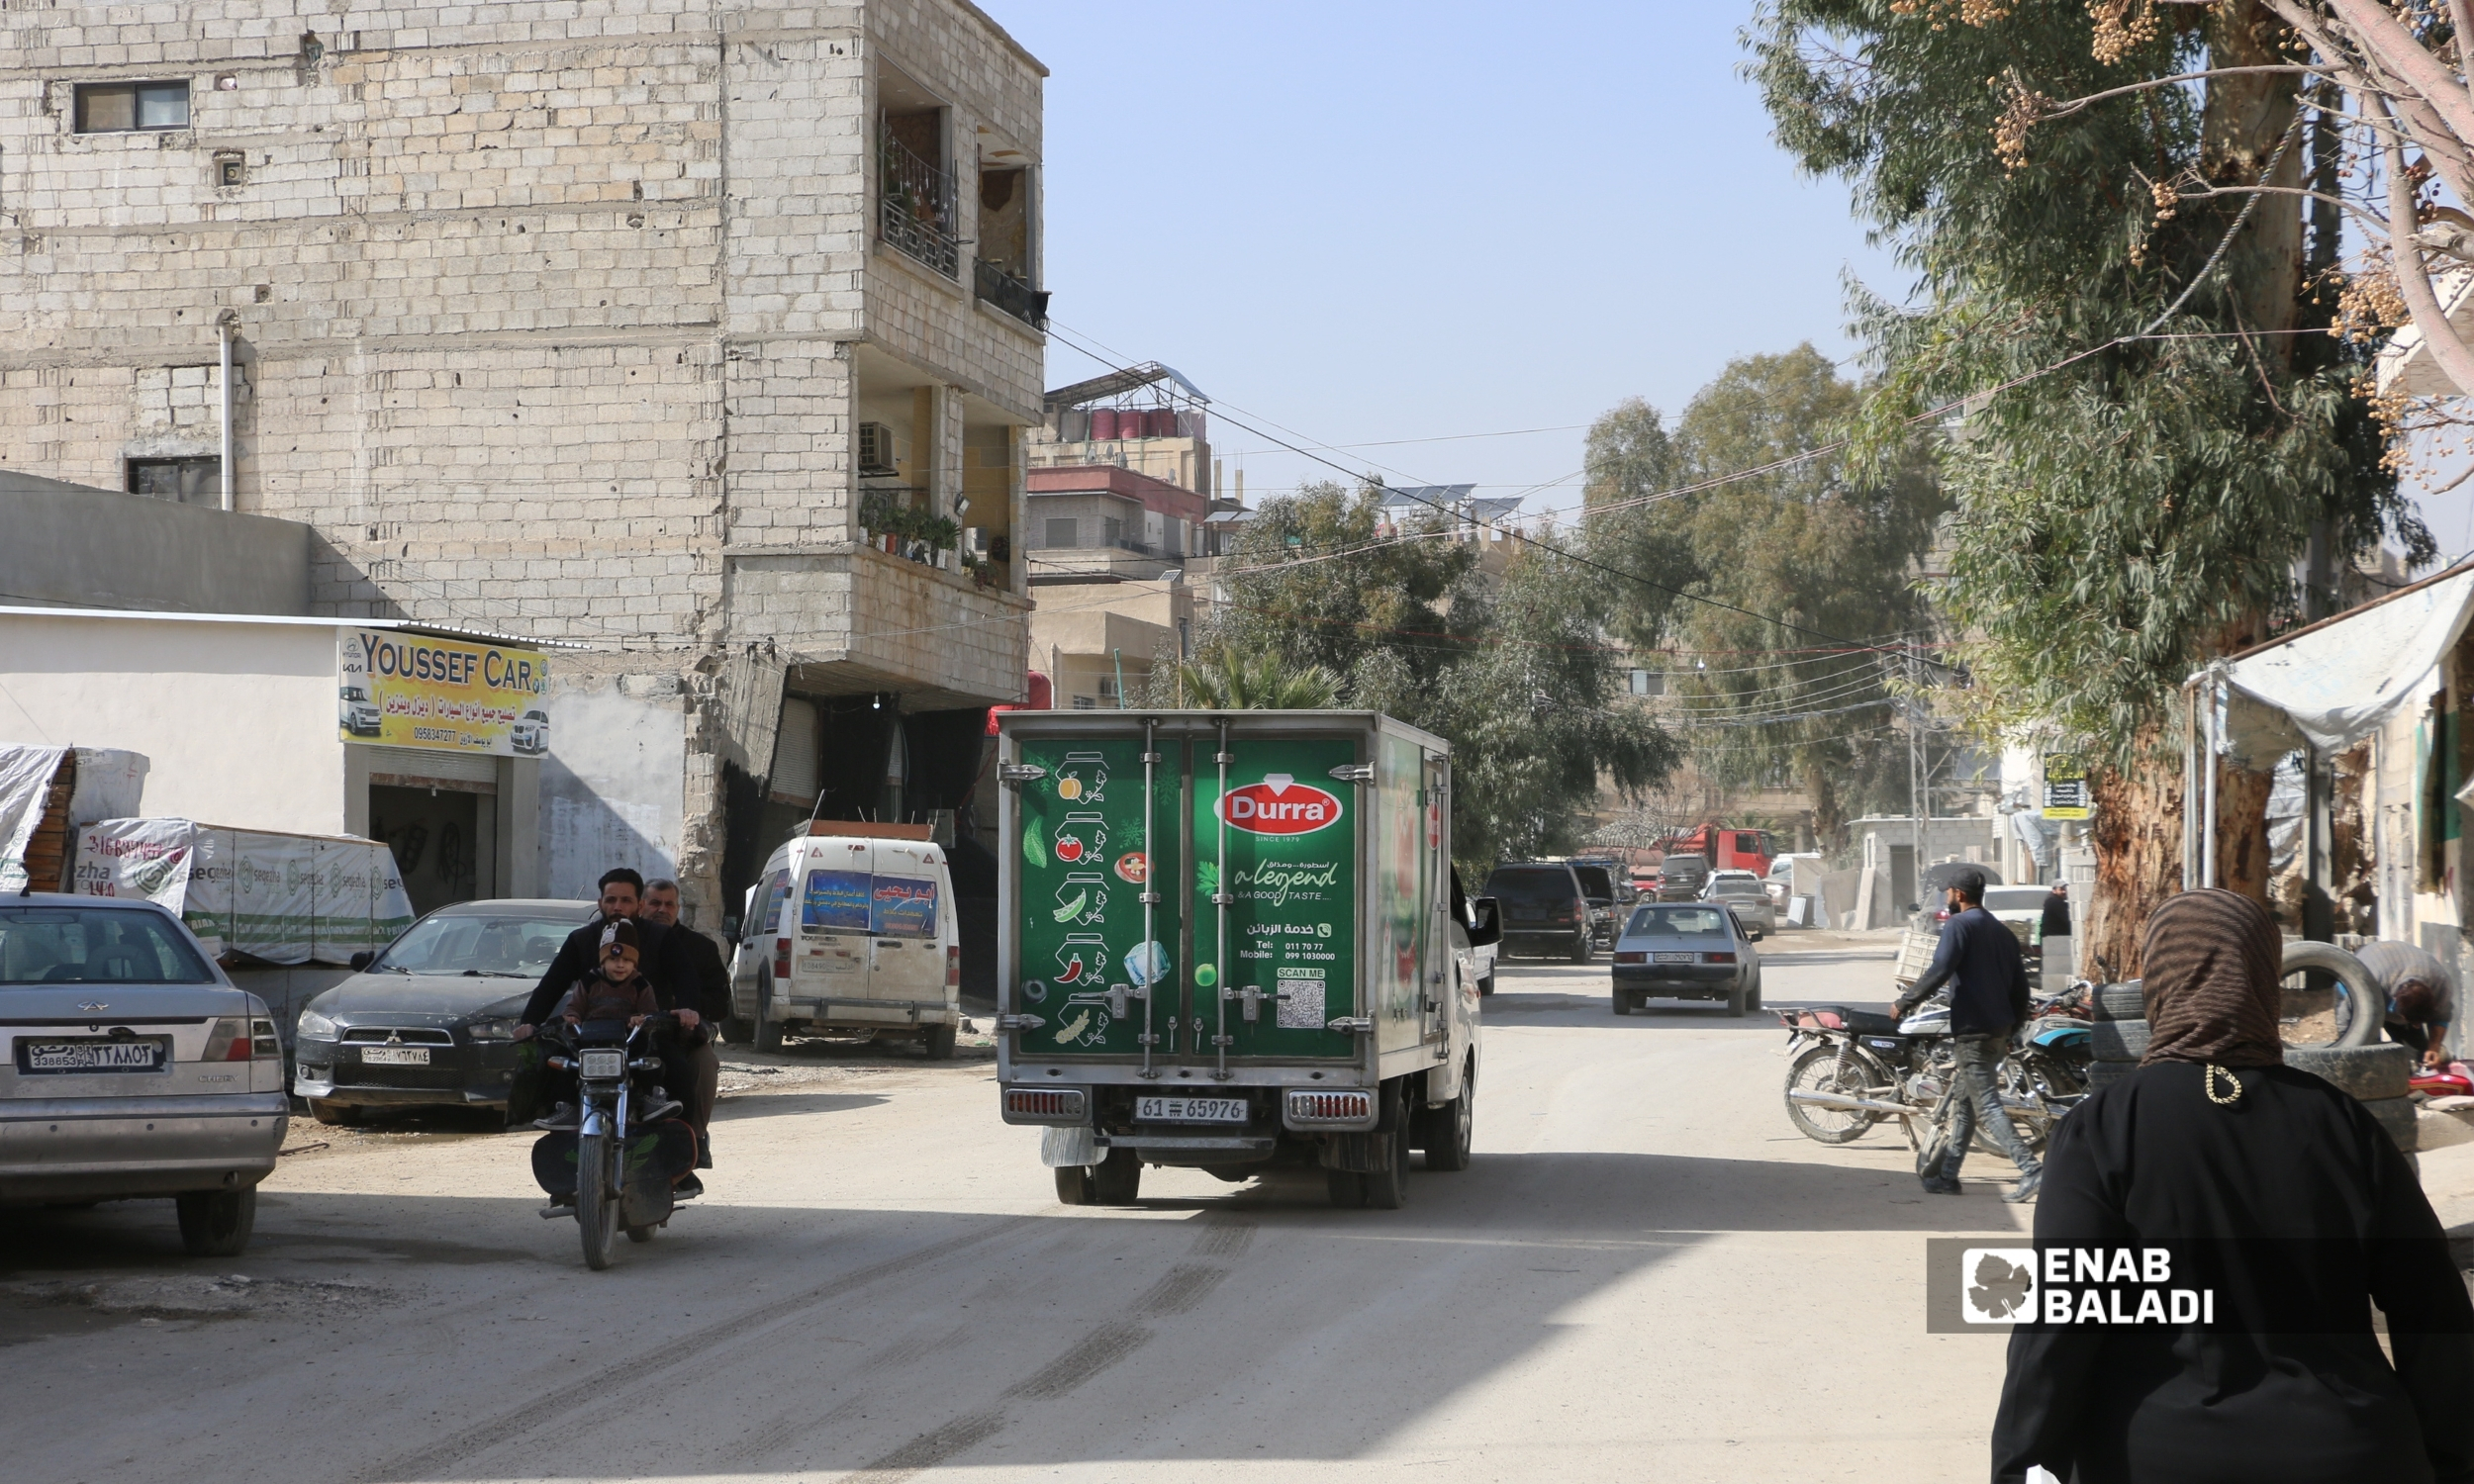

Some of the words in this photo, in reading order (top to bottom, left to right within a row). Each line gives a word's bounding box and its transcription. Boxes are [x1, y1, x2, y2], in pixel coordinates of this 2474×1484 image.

[359, 633, 477, 685] YOUSSEF
[484, 650, 531, 691] CAR
[437, 698, 464, 719] السيارات
[482, 707, 496, 724] جميع
[414, 726, 456, 742] 0958347277
[1232, 795, 1324, 820] Durra
[74, 861, 111, 880] zha
[1234, 870, 1254, 885] a
[1253, 858, 1339, 907] legend
[1253, 890, 1283, 899] GOOD
[1246, 923, 1282, 936] الزبائن
[1284, 924, 1314, 935] خدمة
[1256, 940, 1274, 949] Tel:
[1279, 969, 1306, 977] SCAN
[34, 1057, 76, 1067] 338853
[199, 1074, 239, 1083] CHERY
[1143, 1099, 1163, 1117] 61
[1187, 1099, 1240, 1119] 65976
